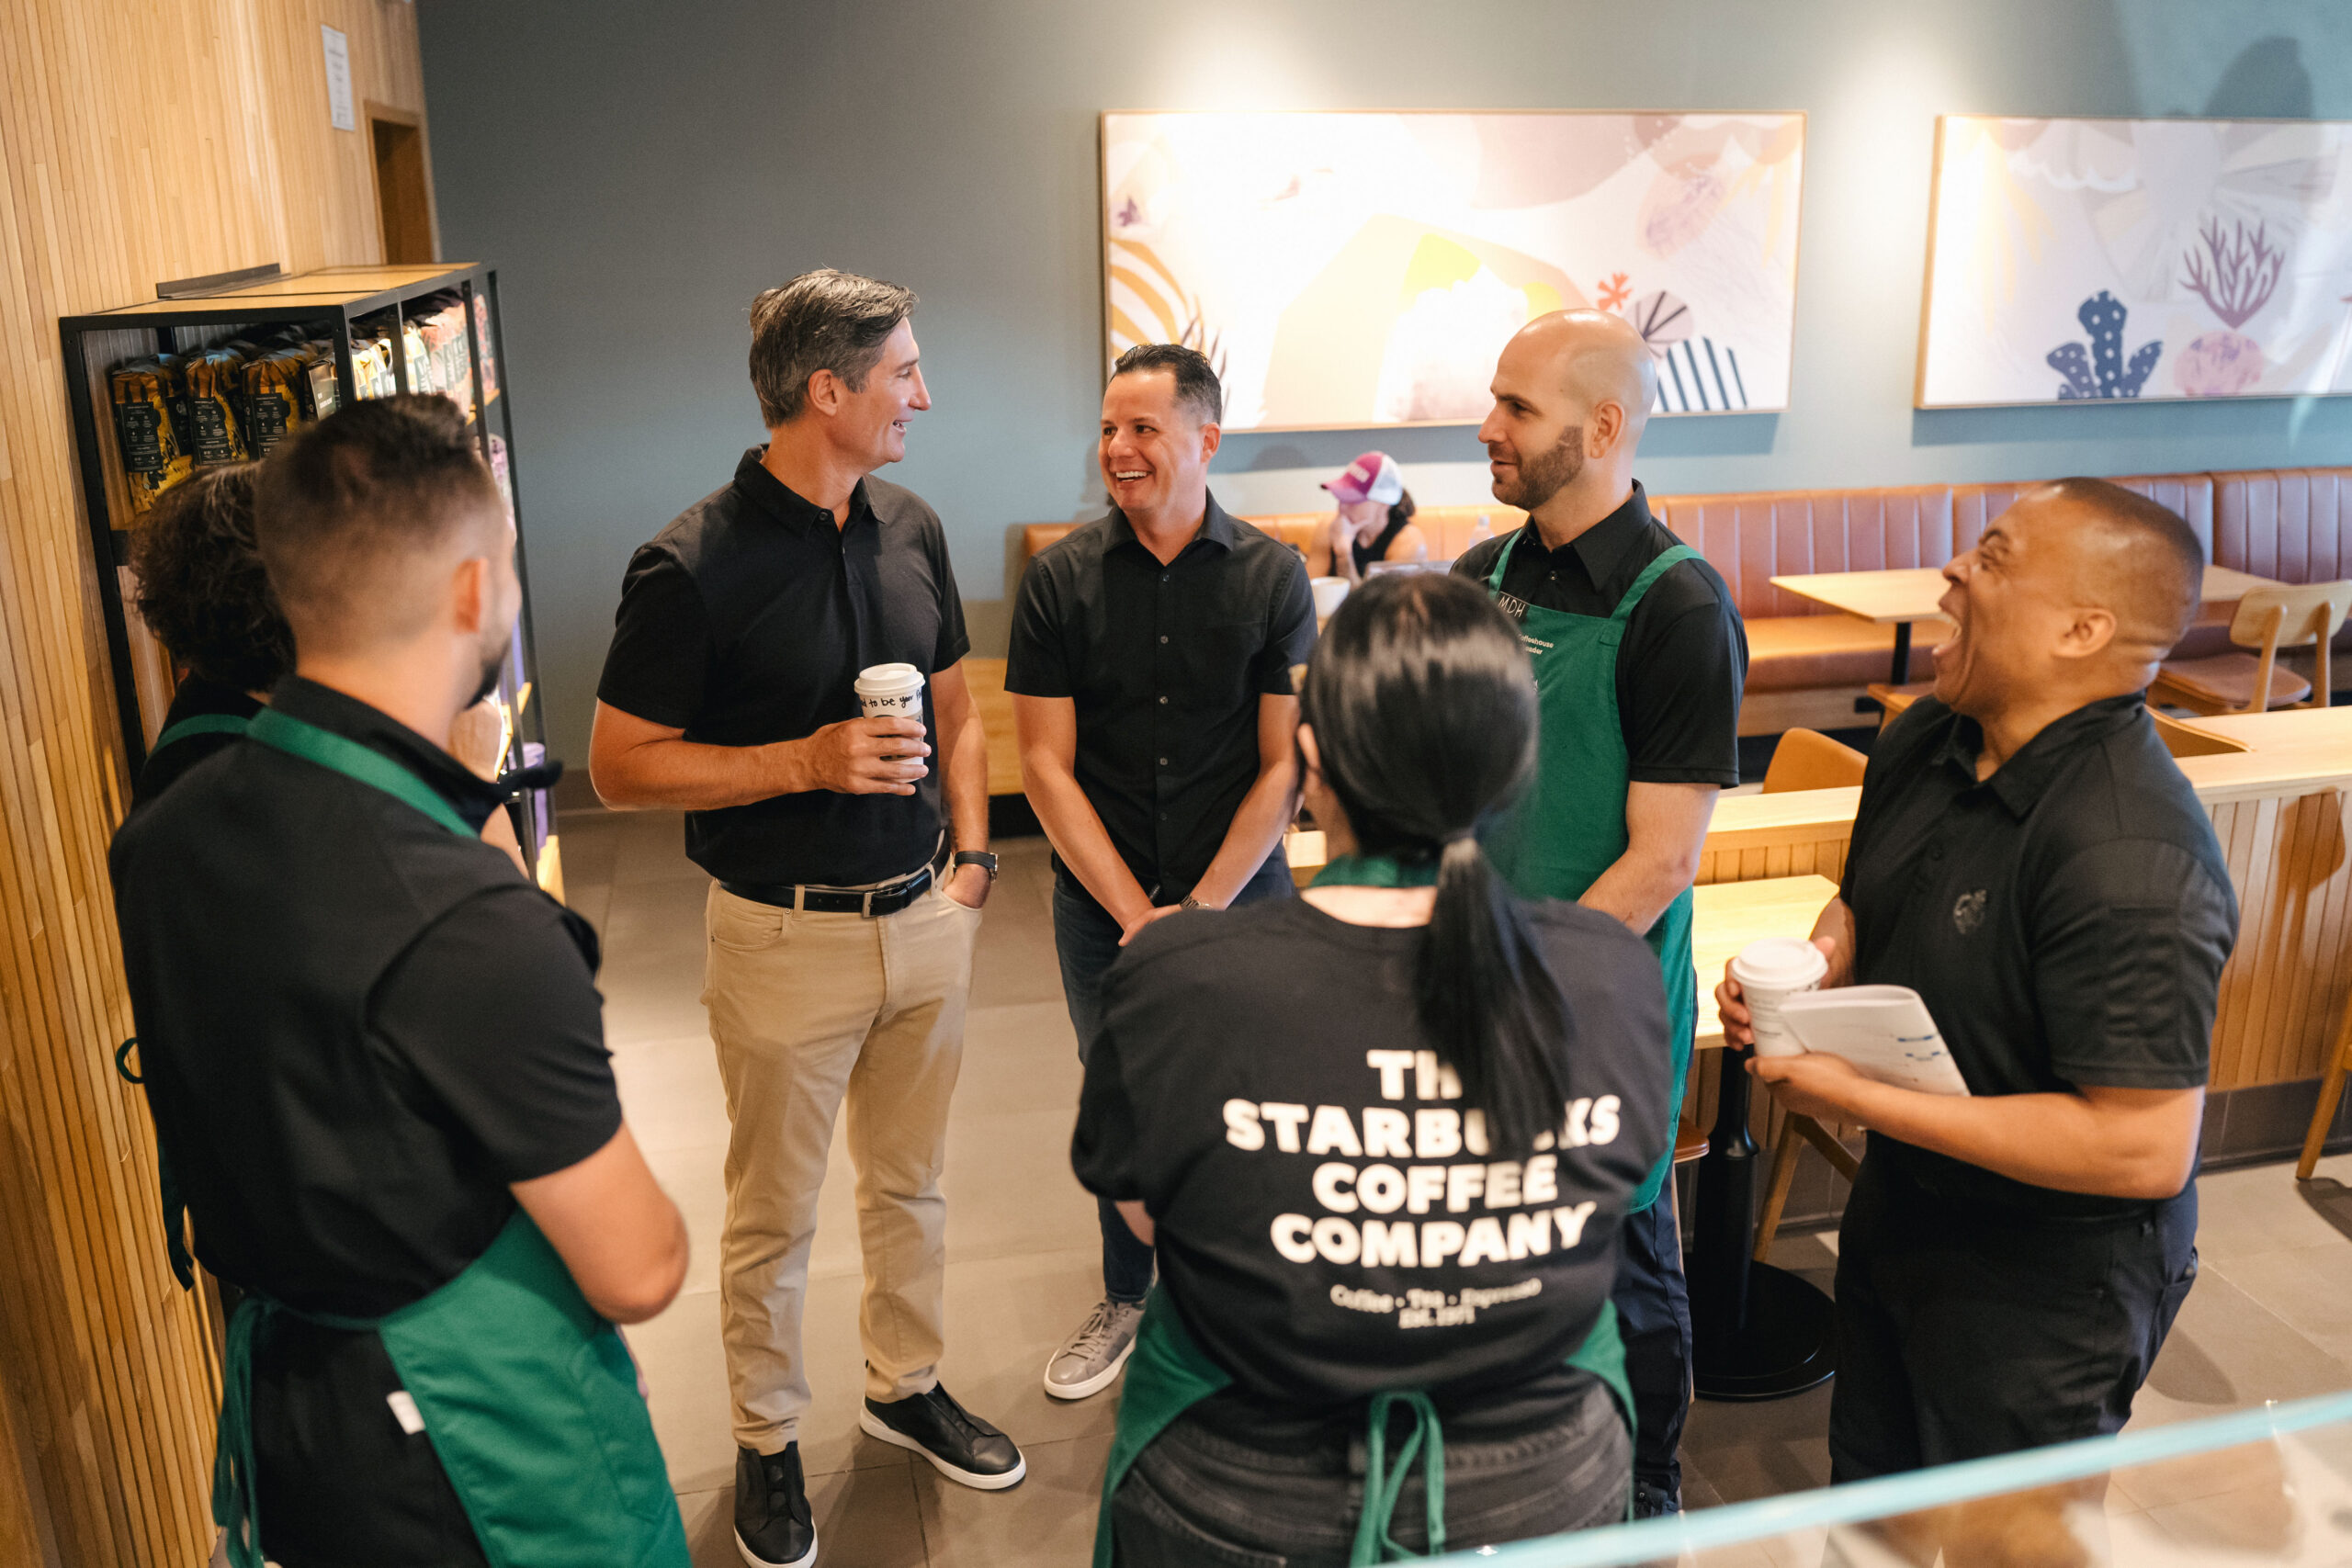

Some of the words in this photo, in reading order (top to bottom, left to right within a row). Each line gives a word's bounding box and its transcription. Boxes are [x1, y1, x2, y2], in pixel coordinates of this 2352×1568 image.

[880, 698, 897, 706] be
[1365, 1049, 1464, 1101] TH
[1222, 1094, 1622, 1159] STARBUKS
[1312, 1154, 1559, 1214] COFFEE
[1270, 1201, 1598, 1269] COMPANY
